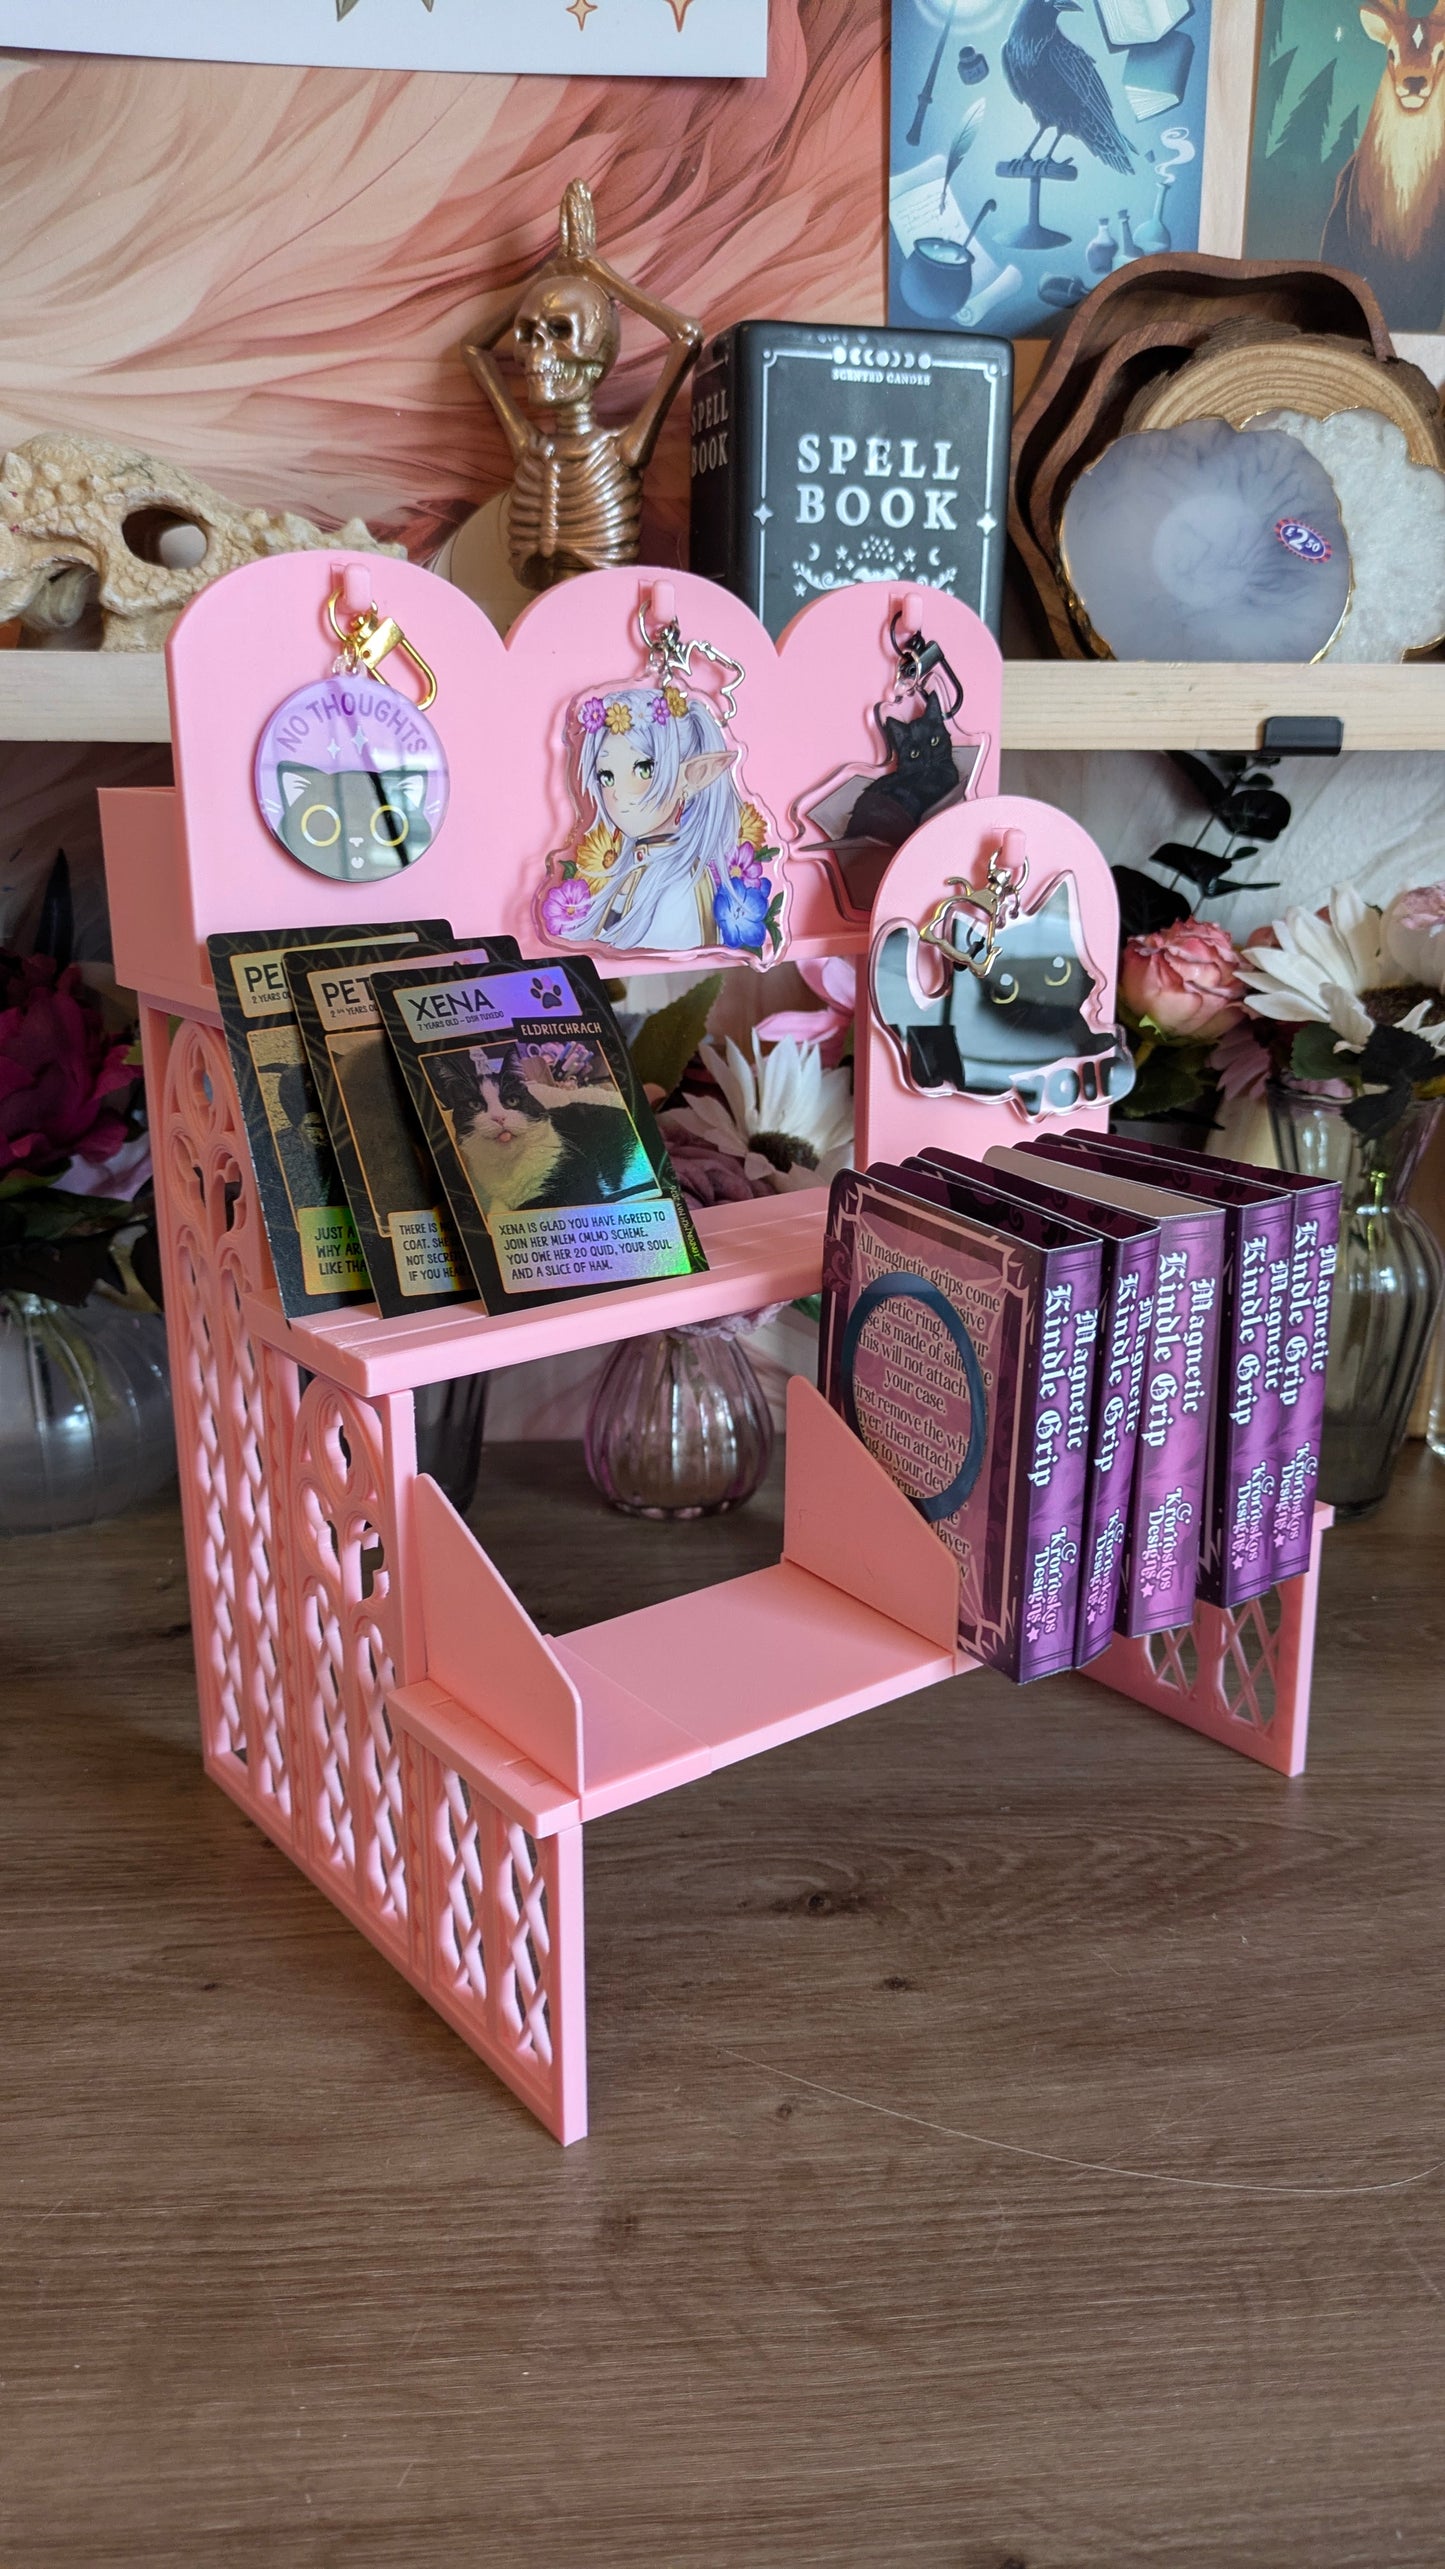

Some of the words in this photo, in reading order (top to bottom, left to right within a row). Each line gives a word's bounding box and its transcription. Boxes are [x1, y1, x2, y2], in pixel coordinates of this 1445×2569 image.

[832, 368, 884, 383] SCENTED
[692, 389, 728, 436] SPELL
[692, 432, 728, 477] BOOK
[797, 434, 960, 480] SPELL
[796, 484, 958, 530] BOOK
[276, 715, 310, 752] NO
[305, 692, 428, 755] THOUGHTS
[244, 963, 289, 992] PE
[258, 992, 281, 1003] YEARS
[345, 1005, 368, 1015] YEARS
[408, 988, 495, 1021] XENA
[424, 1020, 445, 1030] YEARS
[446, 1017, 459, 1026] OLD
[480, 1010, 504, 1020] TUXEDO
[521, 1022, 602, 1036] ELDRITCHRACH
[315, 1226, 343, 1240] JUST
[399, 1223, 427, 1236] THERE
[428, 1222, 438, 1234] IS
[403, 1239, 431, 1251] COAT.
[499, 1221, 525, 1236] XENA
[528, 1222, 538, 1233] IS
[540, 1218, 566, 1231] GLAD
[568, 1216, 589, 1229] YOU
[592, 1214, 616, 1227] HAVE
[617, 1211, 651, 1225] AGREED
[653, 1210, 666, 1222] TO
[504, 1237, 528, 1251] JOIN
[531, 1235, 549, 1248] HER
[550, 1232, 576, 1246] MLEM
[317, 1244, 341, 1258] WHY
[319, 1261, 343, 1276] LIKE
[346, 1259, 368, 1274] THA
[406, 1254, 425, 1267] NOT
[506, 1252, 529, 1265] YOU
[532, 1249, 553, 1262] OWE
[554, 1247, 571, 1261] HER
[574, 1246, 587, 1258] 20
[619, 1240, 646, 1253] YOUR
[647, 1239, 672, 1251] SOUL
[511, 1266, 533, 1280] AND
[536, 1264, 544, 1277] A
[546, 1262, 571, 1276] SLICE
[574, 1260, 586, 1273] OF
[857, 1232, 873, 1254] All
[874, 1245, 928, 1277] magnetic
[930, 1270, 963, 1297] grips
[966, 1285, 1000, 1312] come
[1288, 1221, 1318, 1326] Kindle
[409, 1270, 418, 1282] IF
[420, 1268, 440, 1280] YOU
[1239, 1236, 1267, 1344] Kindle
[1109, 1272, 1139, 1386] Kindle
[1153, 1251, 1187, 1362] Kindle
[1265, 1258, 1289, 1390] Magnetic
[1311, 1244, 1338, 1372] Magnetic
[881, 1316, 891, 1335] is
[893, 1326, 926, 1353] made
[929, 1342, 943, 1360] of
[1040, 1283, 1072, 1399] Kindle
[1182, 1278, 1215, 1413] Magnetic
[859, 1328, 879, 1352] this
[882, 1343, 902, 1365] will
[904, 1356, 924, 1376] not
[926, 1367, 967, 1398] attach
[884, 1370, 913, 1394] your
[1067, 1309, 1098, 1449] Magnetic
[1125, 1295, 1154, 1433] Magnetic
[1280, 1336, 1308, 1406] Grip
[1141, 1373, 1178, 1447] Grip
[1229, 1353, 1261, 1425] Grip
[878, 1396, 921, 1431] remove
[923, 1419, 943, 1443] the
[1094, 1396, 1124, 1472] Grip
[881, 1443, 892, 1461] to
[893, 1453, 923, 1478] your
[885, 1421, 911, 1449] then
[913, 1441, 952, 1473] attach
[1027, 1410, 1062, 1487] Grip
